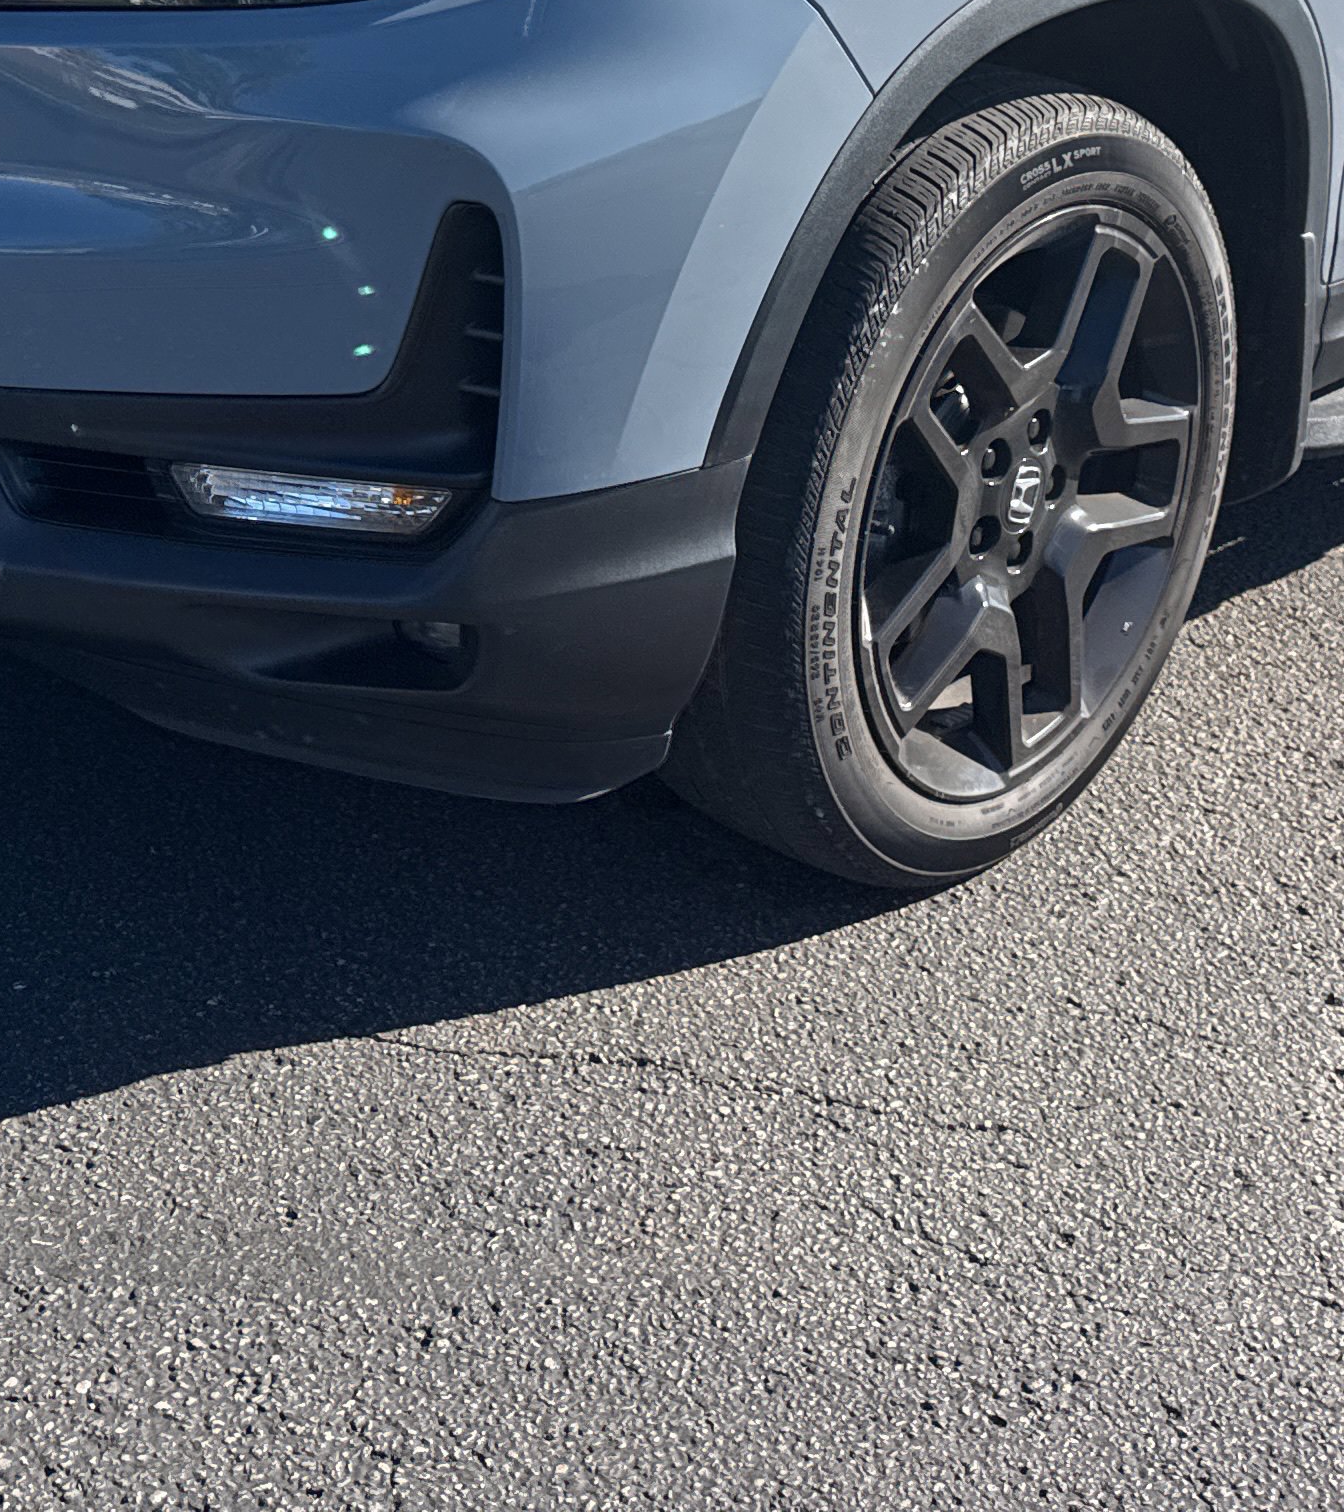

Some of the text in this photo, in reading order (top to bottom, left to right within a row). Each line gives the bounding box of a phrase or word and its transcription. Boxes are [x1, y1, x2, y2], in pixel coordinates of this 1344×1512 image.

[1020, 146, 1101, 185] CROSS LX SPORT
[822, 477, 857, 761] CONTINENTAL
